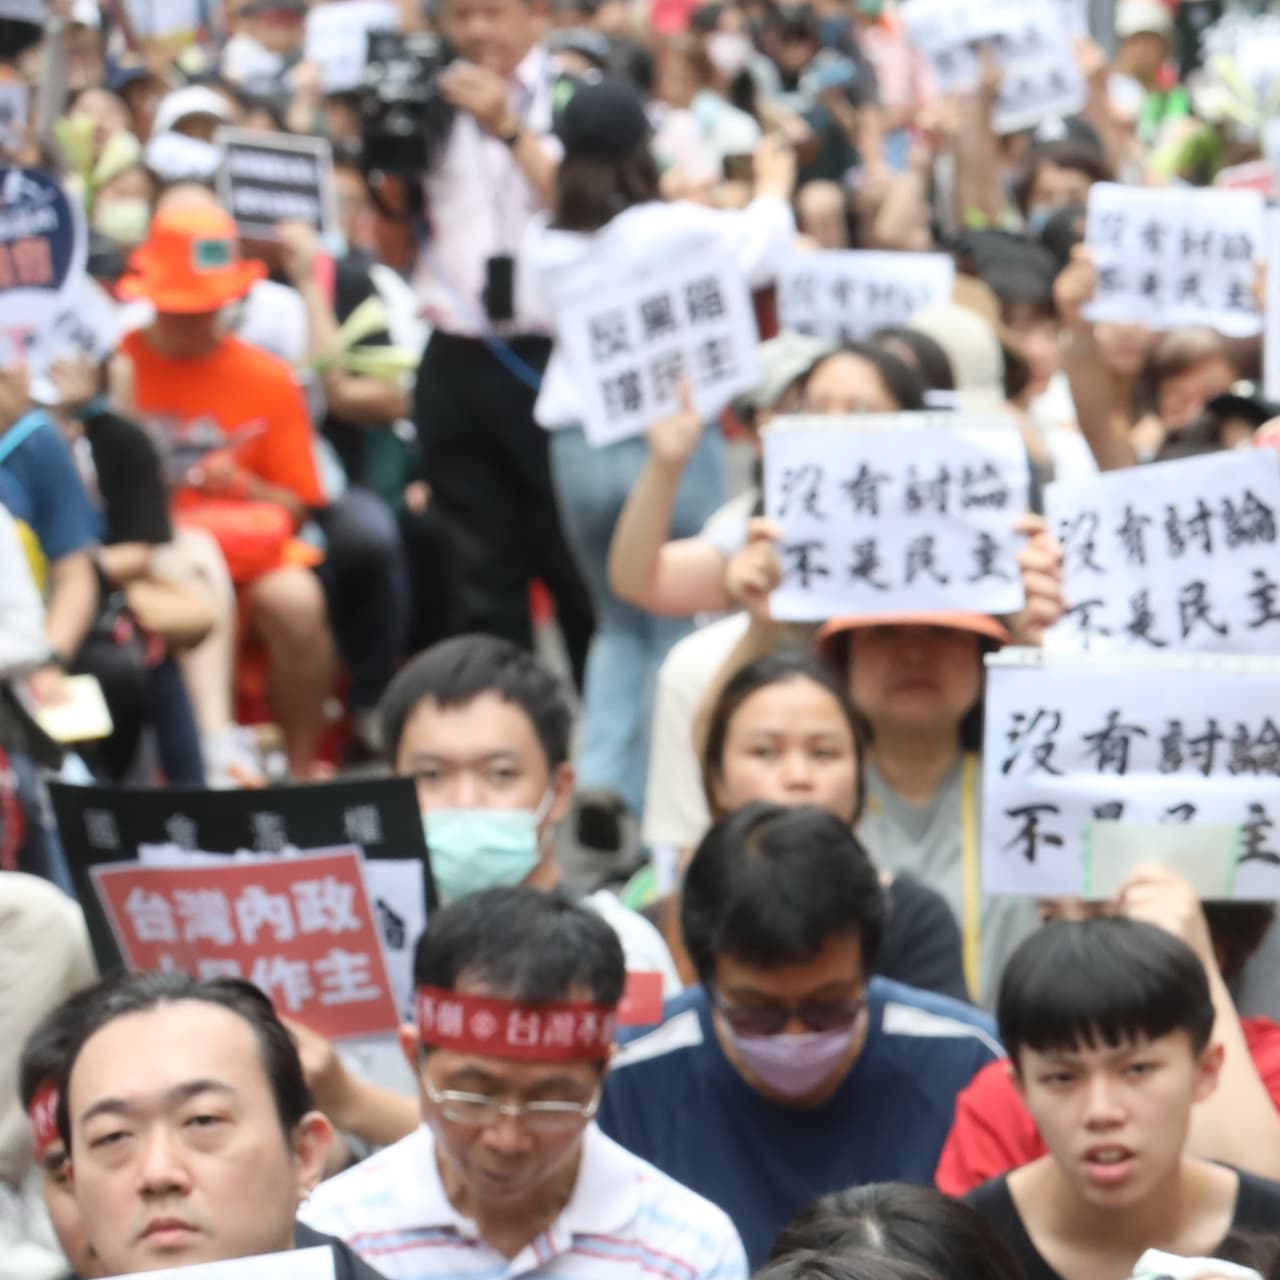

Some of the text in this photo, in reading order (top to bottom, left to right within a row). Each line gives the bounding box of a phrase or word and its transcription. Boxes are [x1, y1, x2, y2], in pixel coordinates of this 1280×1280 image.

[775, 461, 1009, 518] 沒有討論
[781, 533, 1014, 592] 不是民主
[1056, 489, 1280, 577] 沒有討論
[125, 876, 362, 945] 台灣內政
